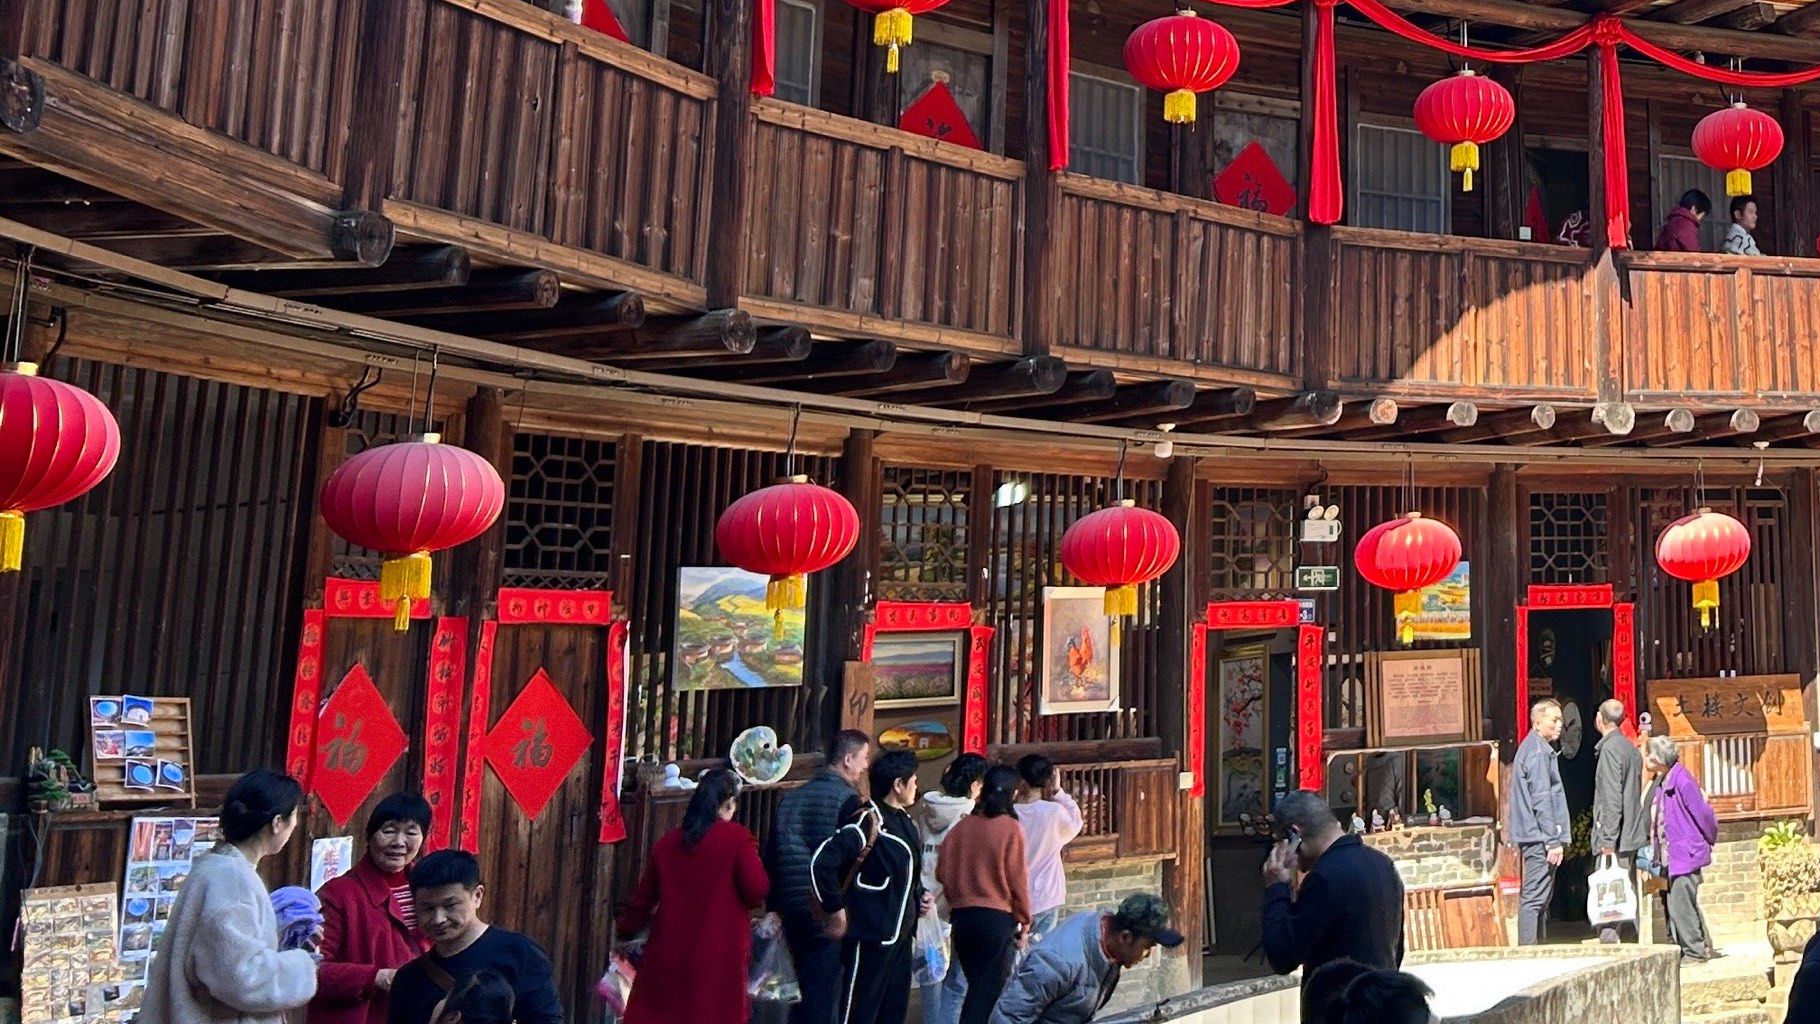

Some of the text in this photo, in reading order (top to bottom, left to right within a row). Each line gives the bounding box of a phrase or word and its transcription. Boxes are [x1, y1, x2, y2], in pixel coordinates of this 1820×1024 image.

[1239, 172, 1267, 212] 福
[320, 712, 367, 774] 福
[511, 717, 554, 769] 福
